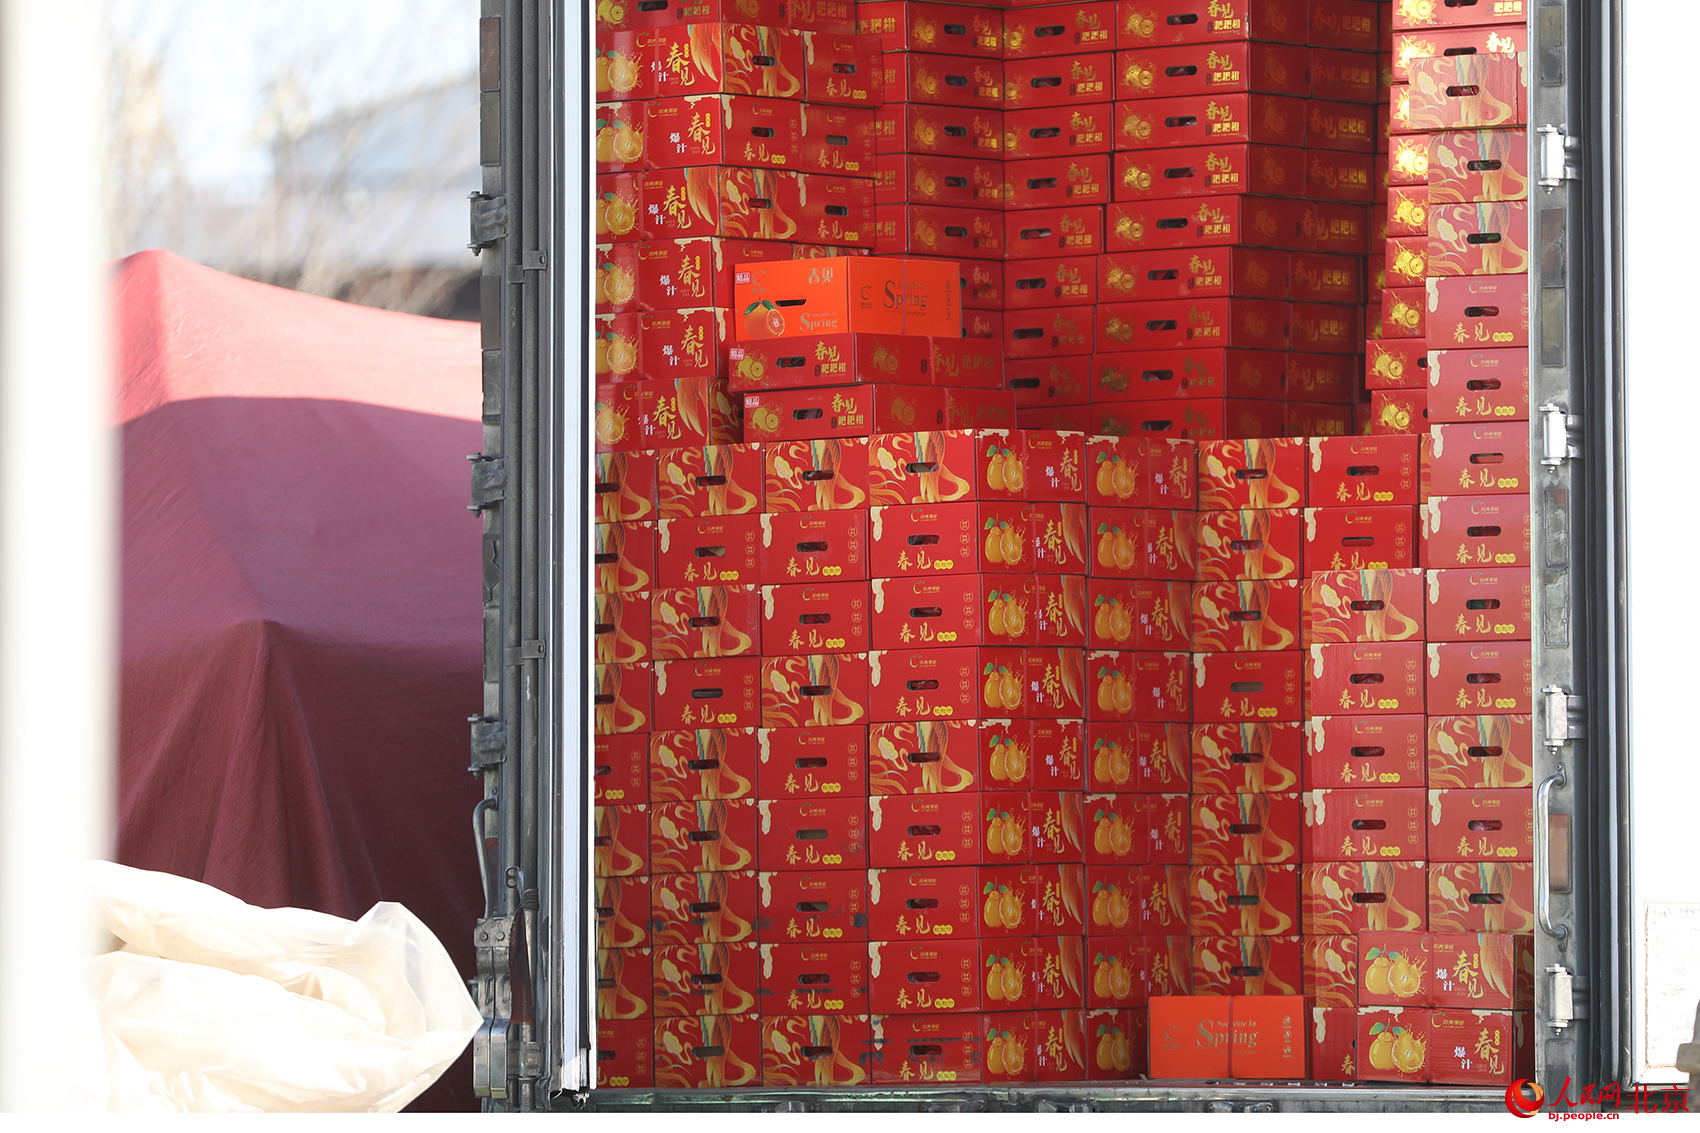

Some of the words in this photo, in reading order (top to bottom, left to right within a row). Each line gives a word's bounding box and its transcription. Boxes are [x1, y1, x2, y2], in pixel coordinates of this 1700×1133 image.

[666, 42, 695, 86] 春见
[826, 77, 851, 98] 春见
[688, 112, 716, 155] 春见
[744, 142, 770, 162] 春见
[818, 151, 844, 169] 春见
[663, 184, 692, 228] 春见
[818, 217, 844, 240] 春见
[678, 255, 706, 298] 春见
[800, 312, 838, 332] Spring
[1454, 322, 1491, 343] 春见
[681, 325, 708, 368] 春见
[1456, 396, 1493, 417] 春见
[653, 396, 682, 442] 春见
[1060, 448, 1082, 492] 春见
[1458, 468, 1496, 489] 春见
[1336, 482, 1371, 502] 春见
[1044, 520, 1067, 564] 春见
[897, 551, 933, 570] 春见
[1331, 552, 1365, 570] 春见
[1456, 544, 1493, 564] 春见
[684, 562, 718, 582] 春见
[786, 556, 822, 576] 春见
[1046, 592, 1068, 637] 春见
[1455, 614, 1493, 634] 春见
[789, 630, 824, 649] 春见
[900, 623, 934, 642] 春见
[1042, 664, 1064, 709] 春见
[896, 696, 932, 716] 春见
[1220, 698, 1254, 717] 春见
[1340, 688, 1377, 709] 春见
[1456, 688, 1494, 708] 春见
[681, 704, 716, 724] 春见
[1059, 736, 1080, 780] 春见
[1341, 763, 1378, 782] 春见
[784, 773, 820, 794] 春见
[1043, 808, 1064, 854] 春见
[786, 844, 821, 865] 春见
[898, 841, 933, 860] 春见
[1341, 836, 1378, 857] 春见
[1457, 836, 1495, 857] 春见
[1042, 881, 1064, 927] 春见
[786, 918, 821, 938] 春见
[896, 915, 932, 935] 春见
[1043, 953, 1064, 999] 春见
[1436, 968, 1454, 991] 爆汁
[1453, 950, 1485, 999] 春见
[787, 990, 822, 1010] 春见
[897, 988, 932, 1008] 春见
[1046, 1026, 1068, 1072] 春见
[1454, 1047, 1472, 1069] 爆汁
[1474, 1028, 1504, 1075] 春见
[899, 1060, 934, 1081] 春见
